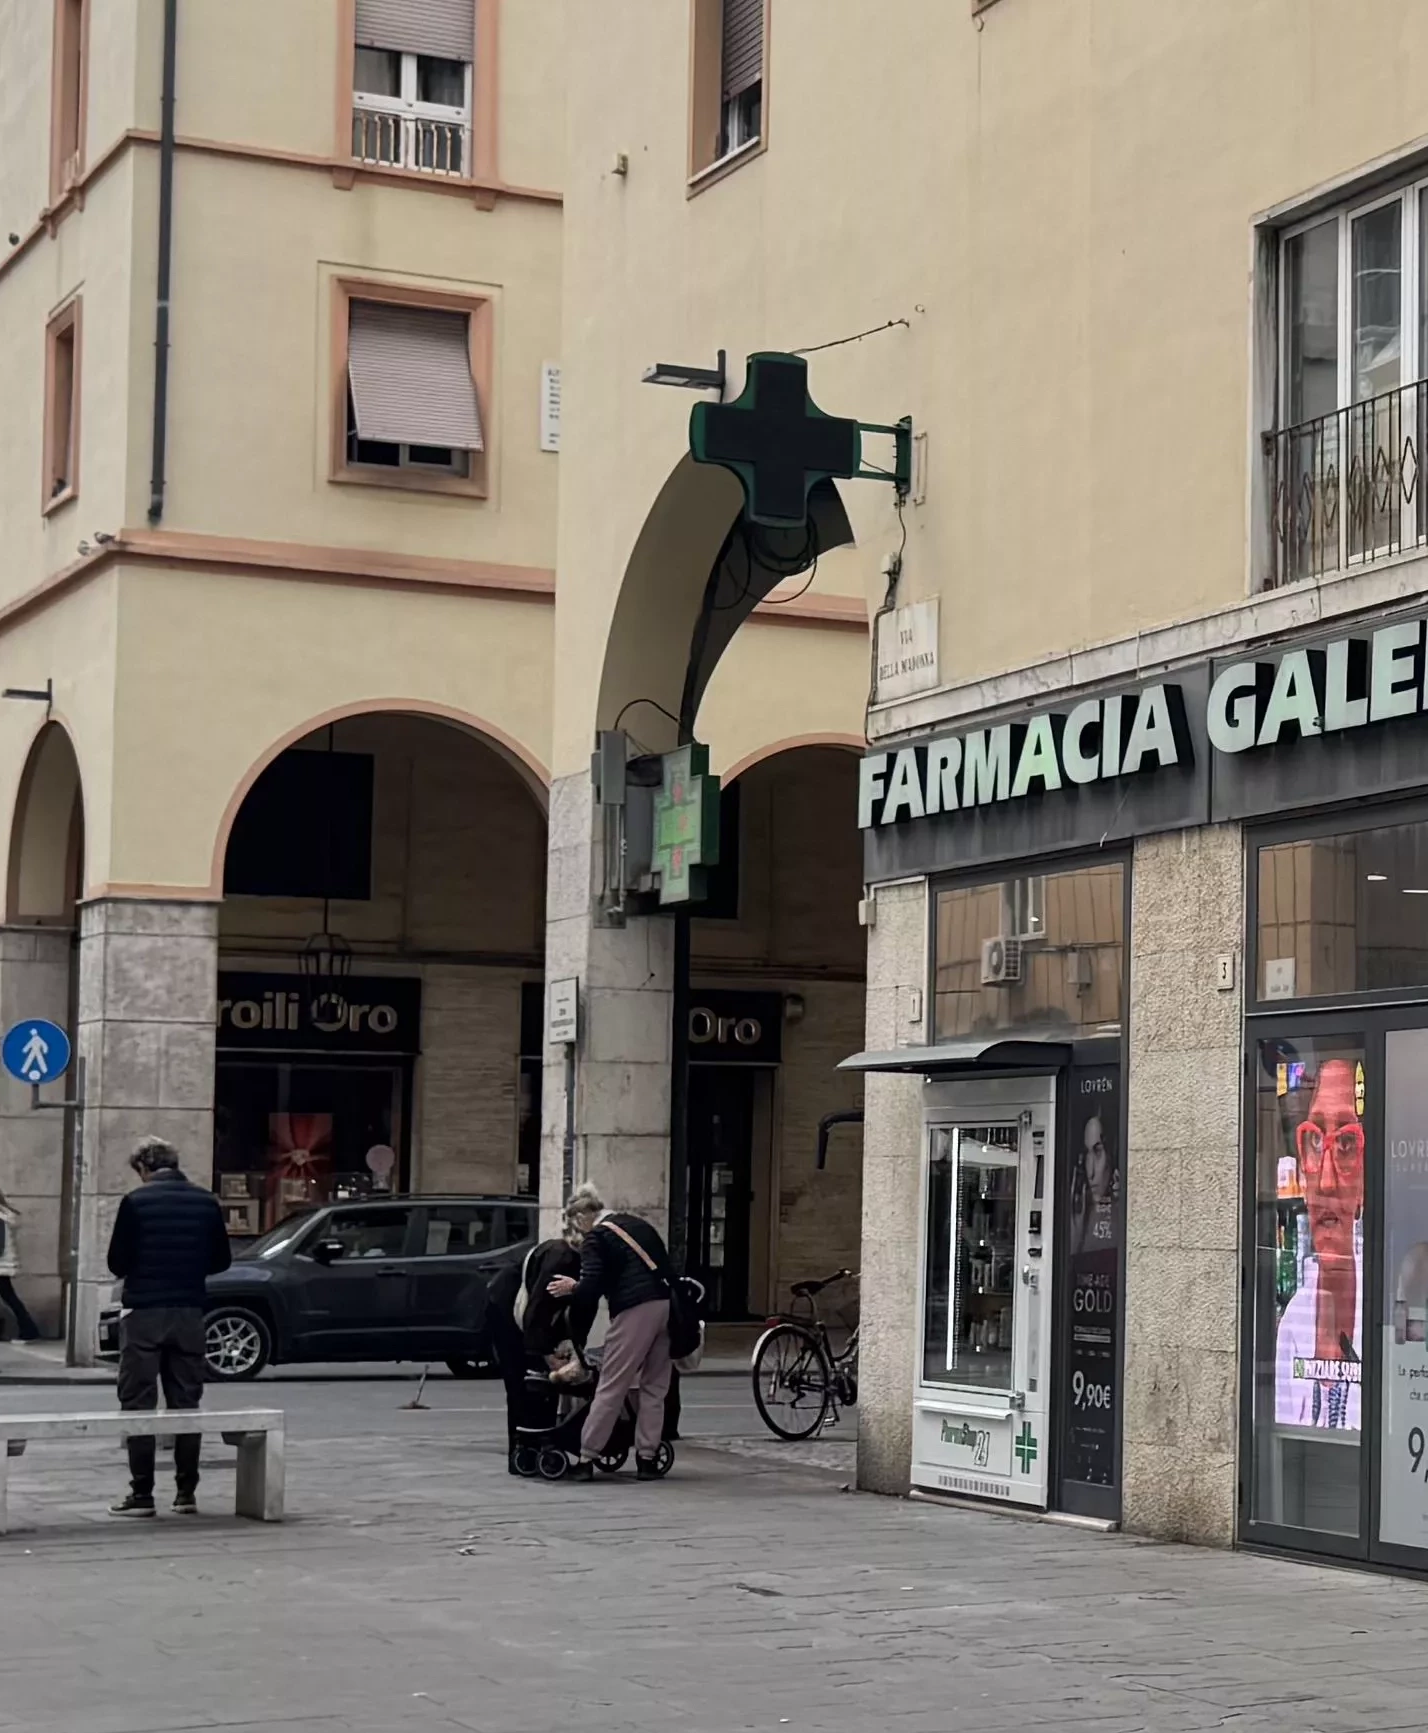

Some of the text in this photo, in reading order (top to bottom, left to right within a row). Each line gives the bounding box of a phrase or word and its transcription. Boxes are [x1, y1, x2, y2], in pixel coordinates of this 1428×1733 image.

[900, 628, 913, 645] VIA
[879, 661, 900, 681] DELLA
[858, 685, 1179, 828] FARMACIA
[311, 993, 398, 1034] Oro
[688, 1006, 762, 1046] Oro
[1073, 1288, 1113, 1313] GOLD
[1072, 1369, 1111, 1411] 9,90€
